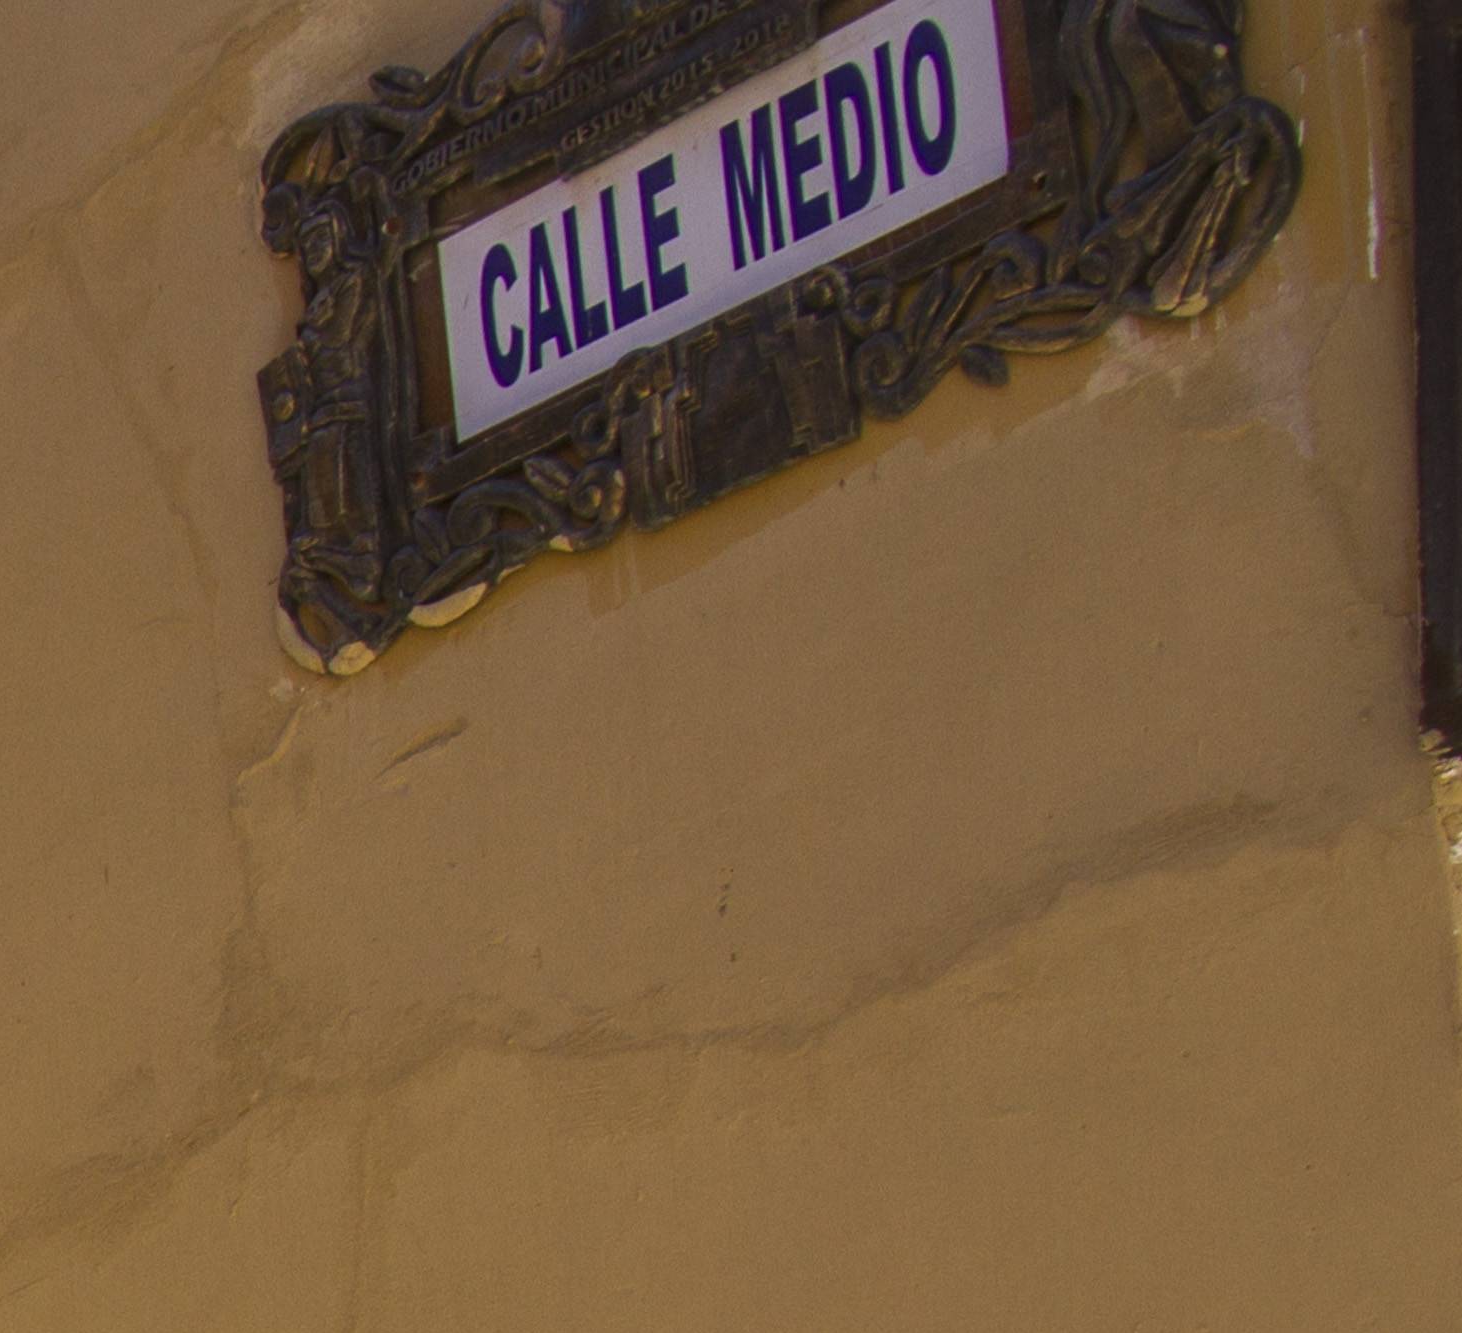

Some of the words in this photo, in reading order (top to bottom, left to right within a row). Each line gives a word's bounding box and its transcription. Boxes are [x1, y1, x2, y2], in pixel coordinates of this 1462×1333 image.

[391, 106, 526, 194] GOBIERNO
[525, 20, 686, 122] MUNICIPAL
[559, 87, 659, 154] GESTION
[478, 153, 689, 389] CALLE
[717, 17, 958, 273] MEDIO
